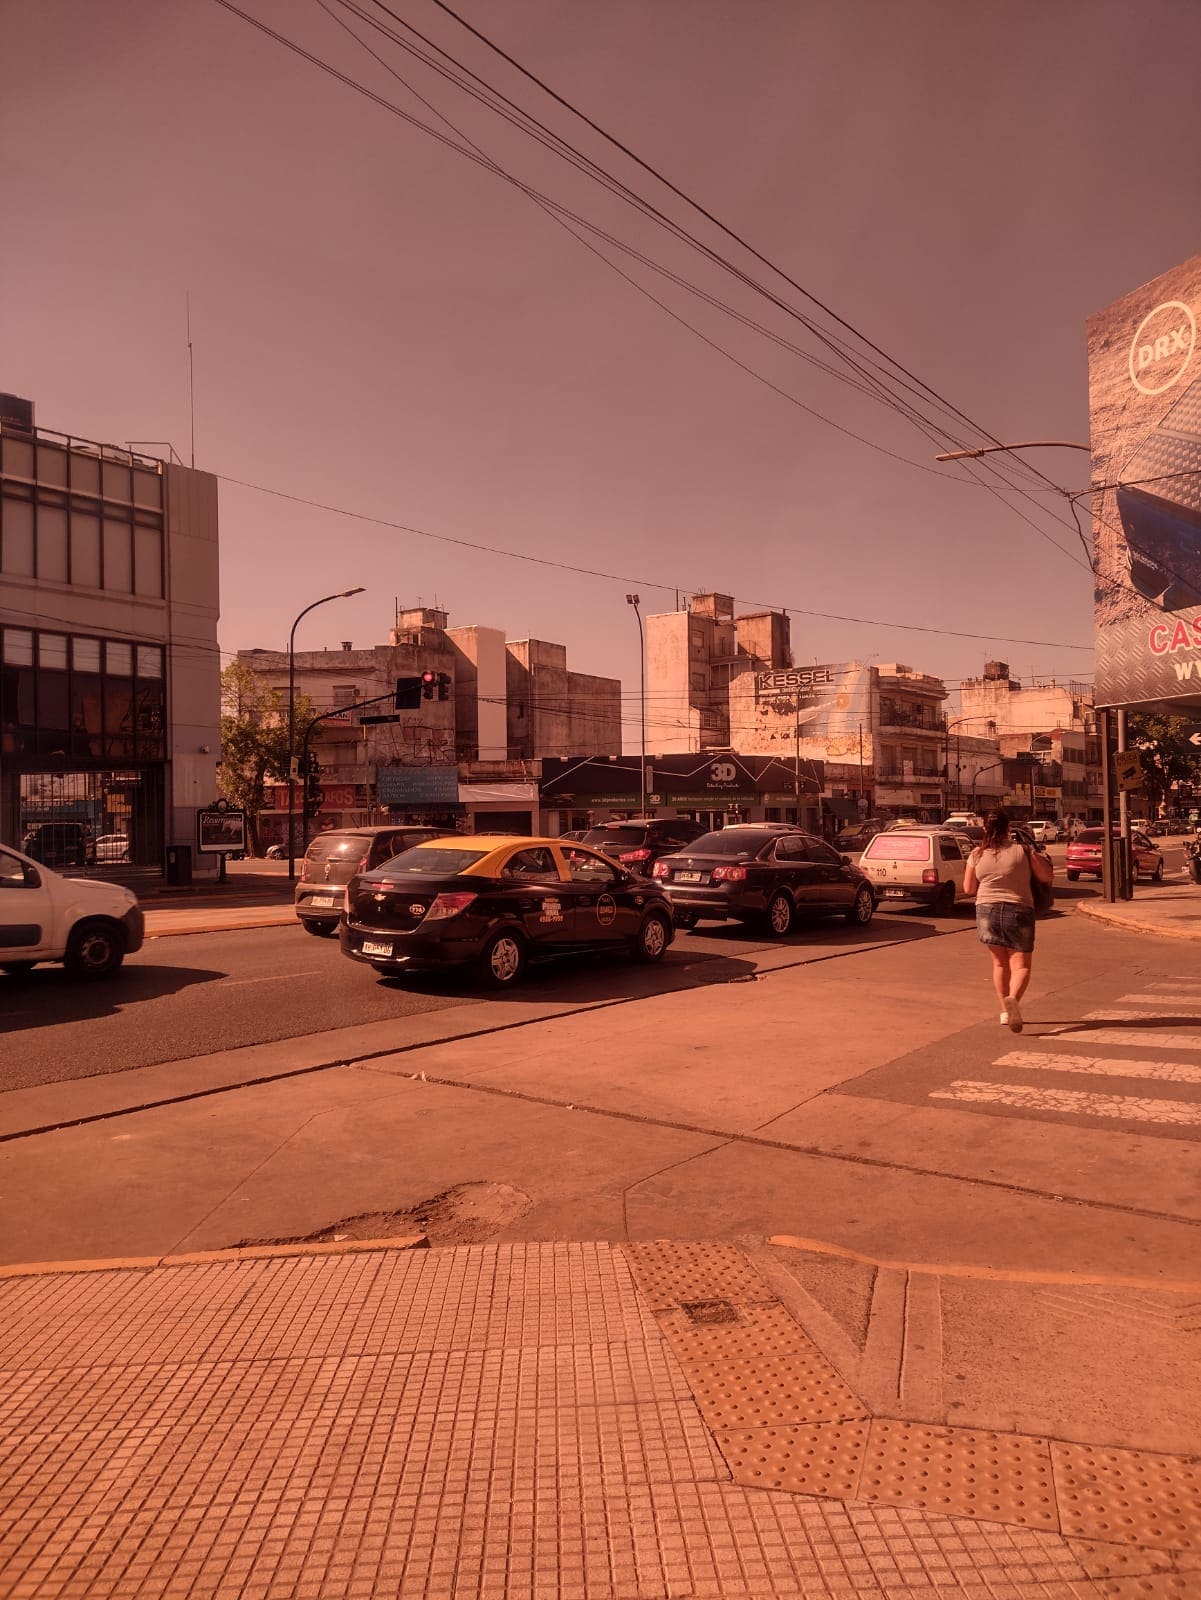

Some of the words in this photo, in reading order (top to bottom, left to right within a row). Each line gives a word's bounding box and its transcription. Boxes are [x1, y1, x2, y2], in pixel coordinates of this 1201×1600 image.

[1138, 325, 1187, 370] DRX
[758, 669, 835, 690] KESSEL
[710, 762, 737, 782] 3D
